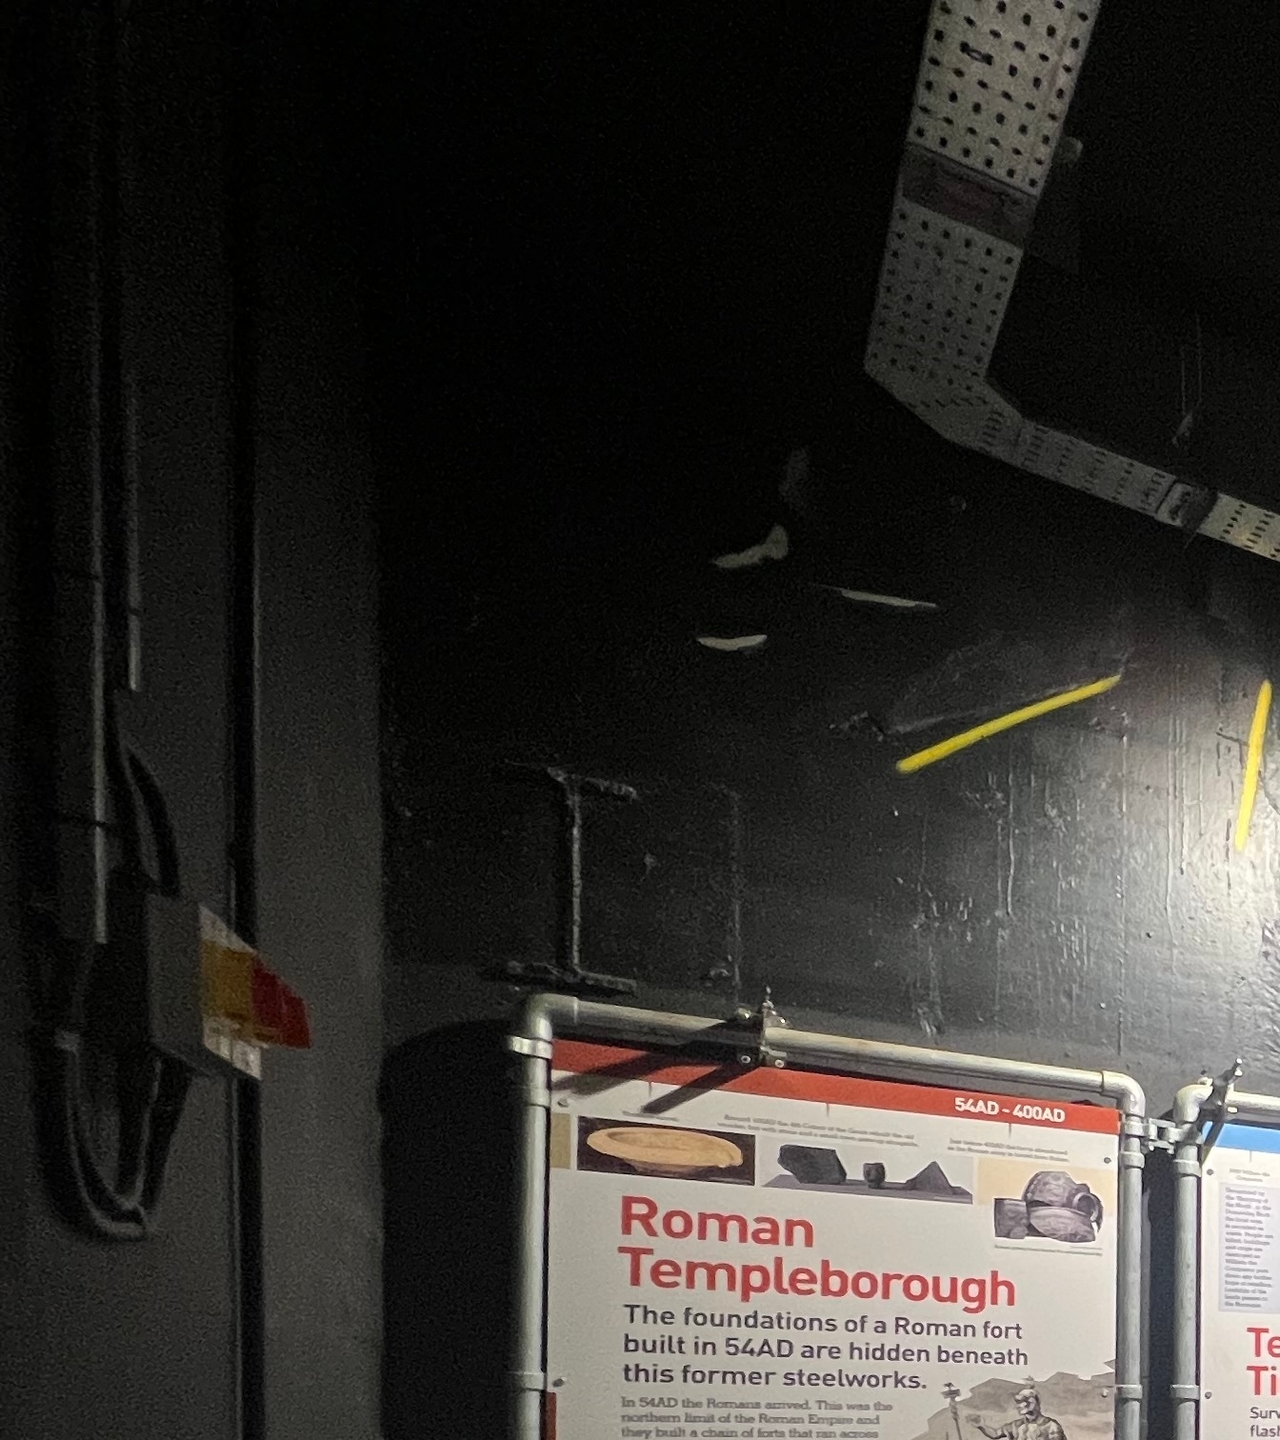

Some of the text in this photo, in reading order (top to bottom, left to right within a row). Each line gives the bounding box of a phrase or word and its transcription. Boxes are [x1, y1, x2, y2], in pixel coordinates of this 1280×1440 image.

[955, 1097, 999, 1115] 54AD
[1013, 1104, 1065, 1122] 400AD
[621, 1196, 813, 1248] Roman
[617, 1246, 1015, 1314] Templeborough
[623, 1304, 1022, 1339] The foundations of a Roman fort
[624, 1333, 1028, 1365] built in 54AD are hidden beneath
[624, 1364, 926, 1389] this former steelworks.
[621, 1396, 636, 1408] In
[639, 1397, 678, 1408] 54AD
[682, 1398, 703, 1408] the
[707, 1398, 761, 1409] Romans
[815, 1400, 843, 1410] This
[874, 1401, 893, 1411] the
[621, 1412, 880, 1426] northern limit of the Roman Empire and
[621, 1426, 652, 1440] they
[655, 1426, 686, 1437] built
[690, 1430, 698, 1438] a
[701, 1427, 738, 1438] chain
[741, 1427, 754, 1438] of
[757, 1428, 786, 1438] forts
[789, 1428, 813, 1438] that
